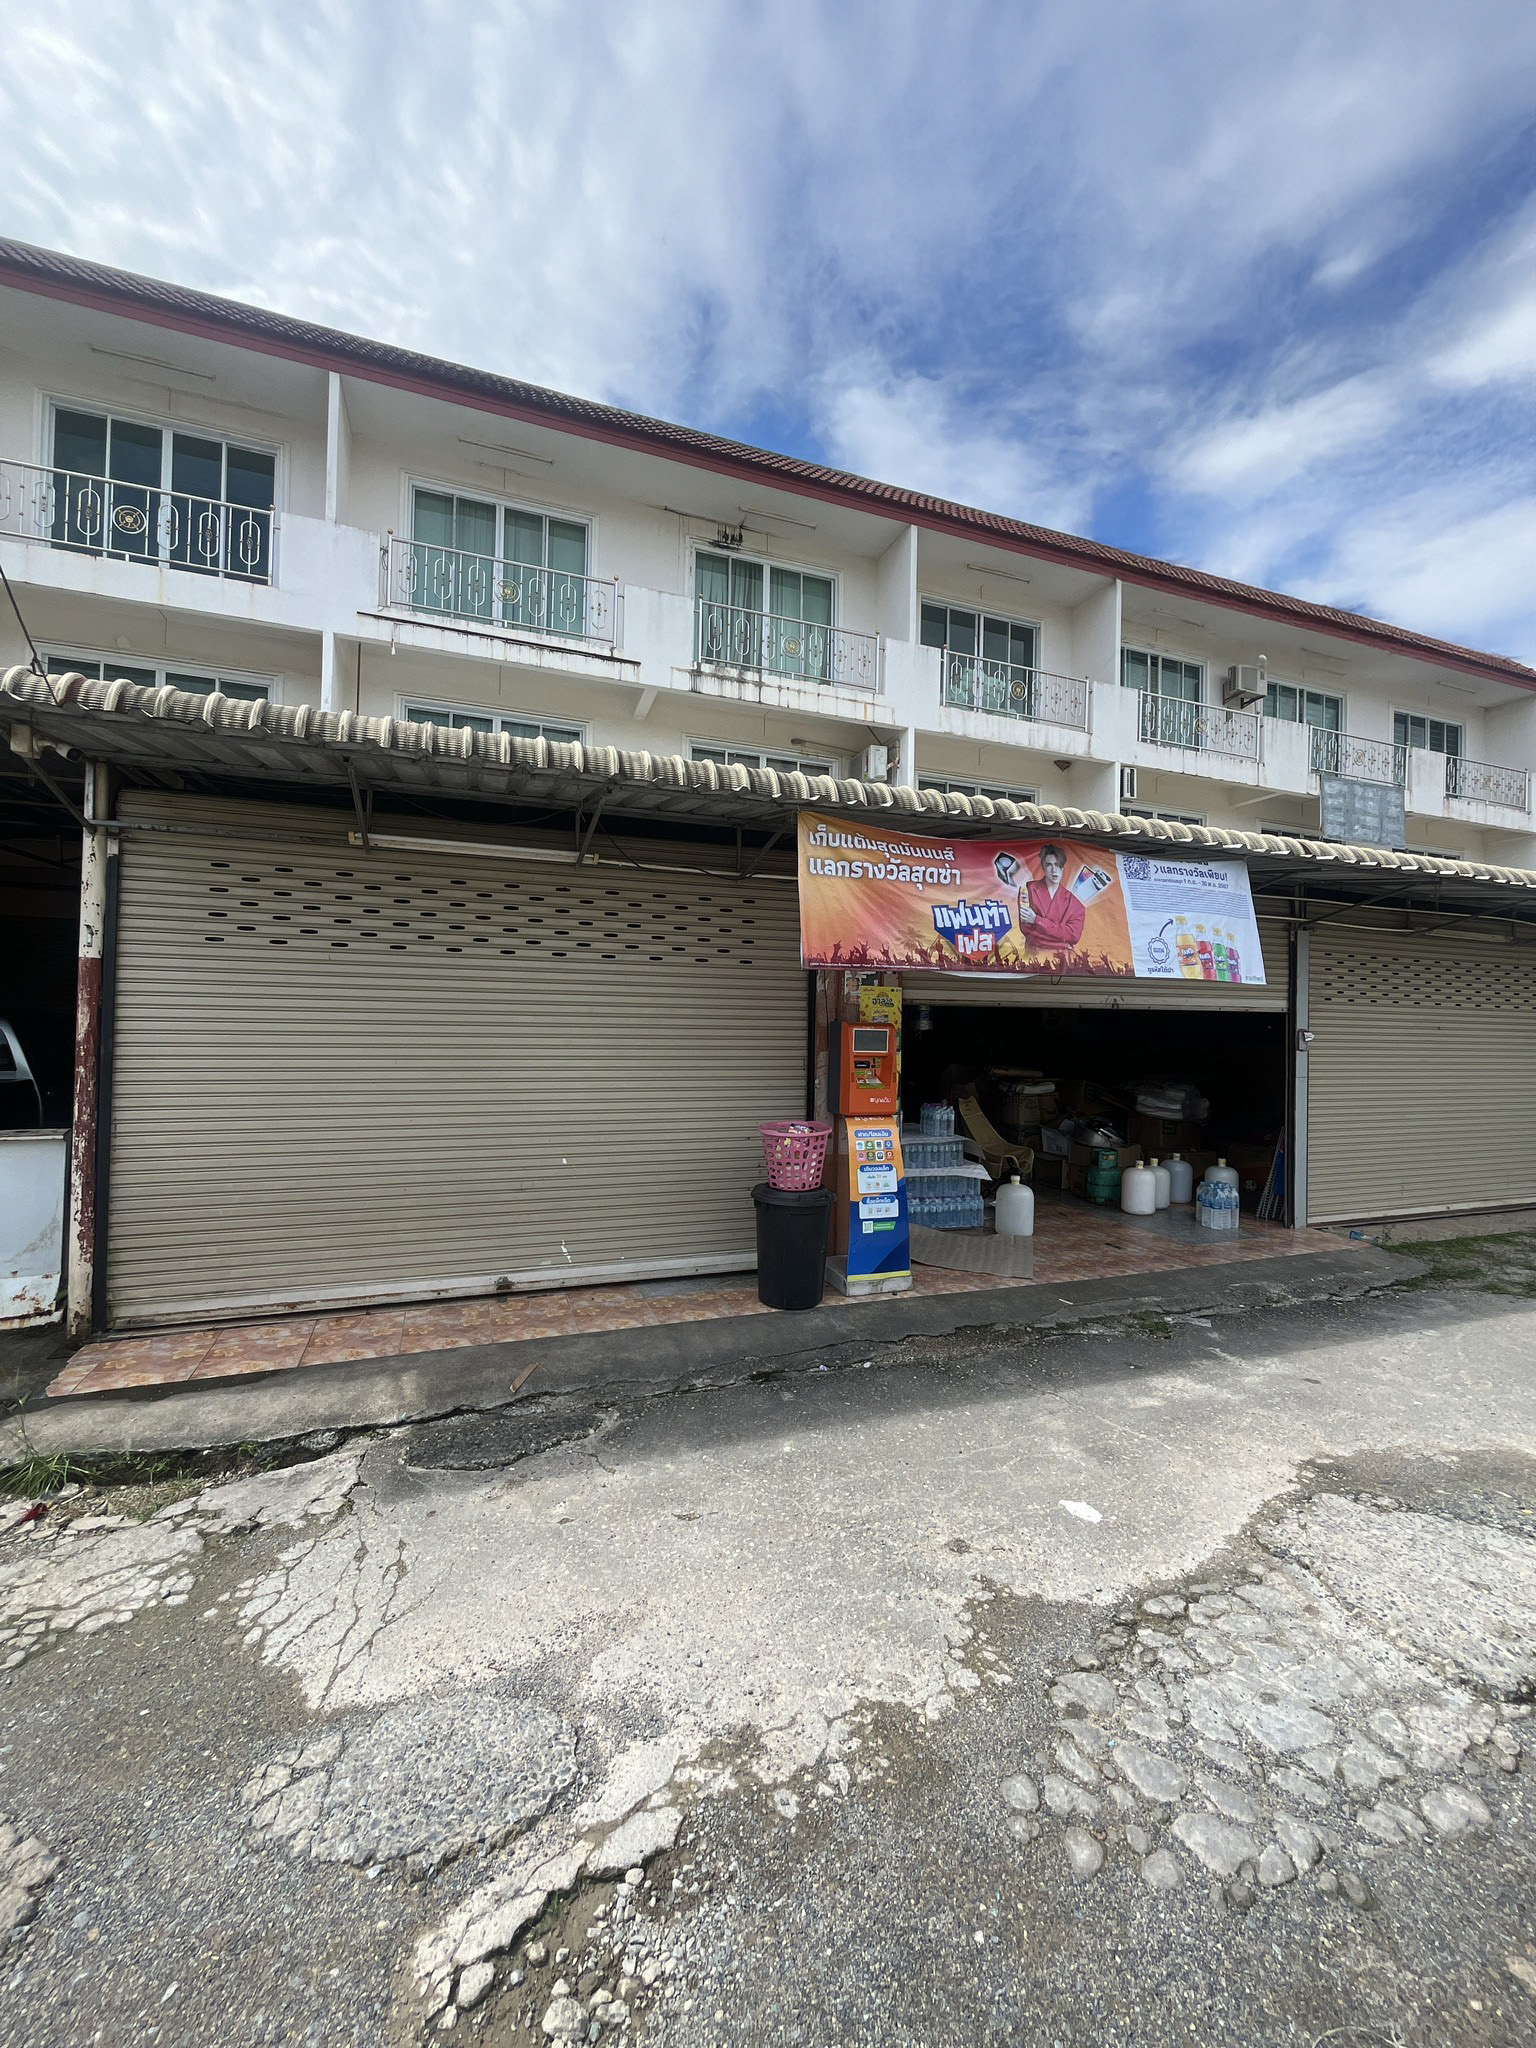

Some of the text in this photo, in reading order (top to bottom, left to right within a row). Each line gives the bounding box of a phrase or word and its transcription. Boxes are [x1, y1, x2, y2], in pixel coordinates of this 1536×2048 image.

[809, 824, 955, 861] เก็บแต้มสุดมันนนส์
[809, 857, 961, 890] แลกรางวัลสุดซ่า
[934, 900, 1011, 930] แฟนต้า
[957, 929, 993, 955] เฟส
